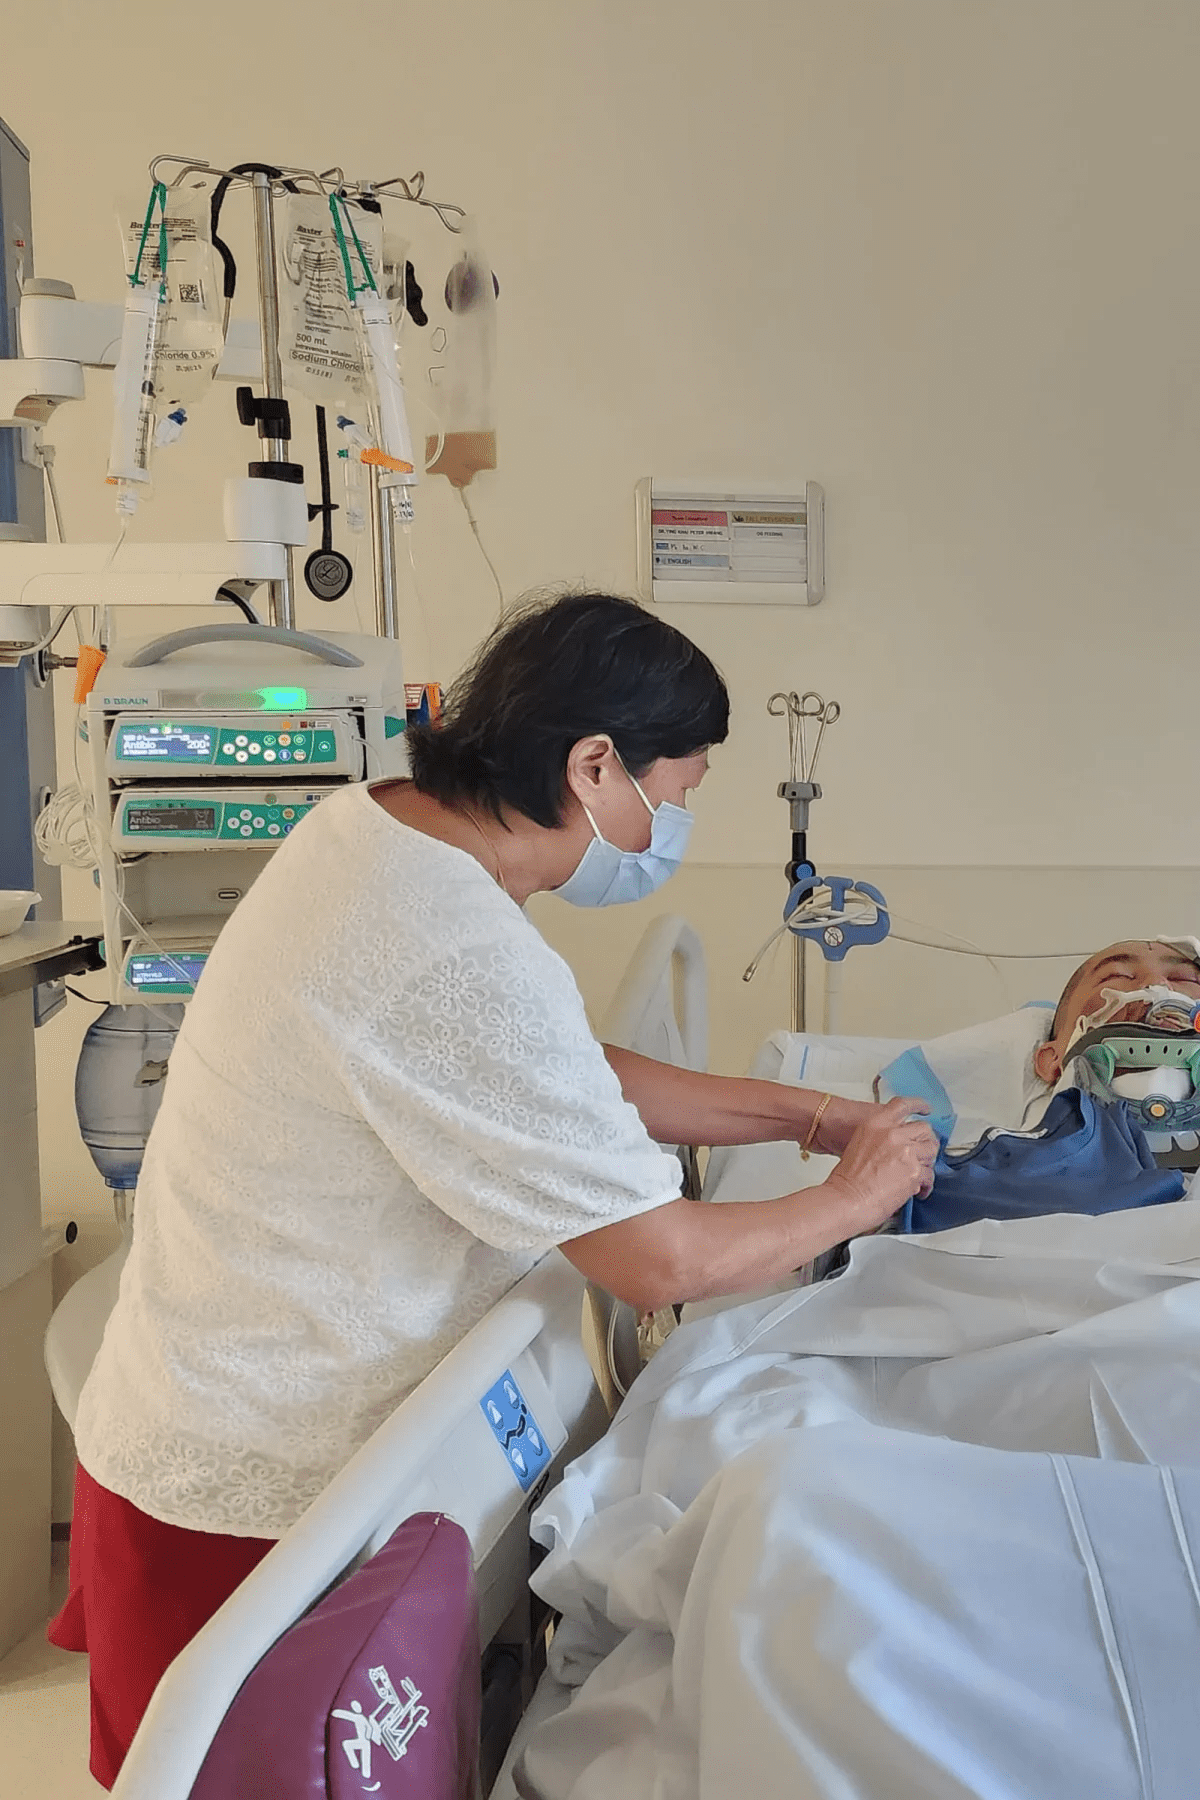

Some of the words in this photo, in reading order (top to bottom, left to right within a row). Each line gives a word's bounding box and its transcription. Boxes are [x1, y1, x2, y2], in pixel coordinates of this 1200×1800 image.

[296, 333, 312, 343] 500
[313, 336, 328, 347] mL
[154, 350, 189, 360] Chloride
[191, 348, 215, 359] 0.9%
[295, 342, 330, 354] Intravenous
[291, 350, 328, 366] Sodium
[130, 816, 160, 824] Antibio
